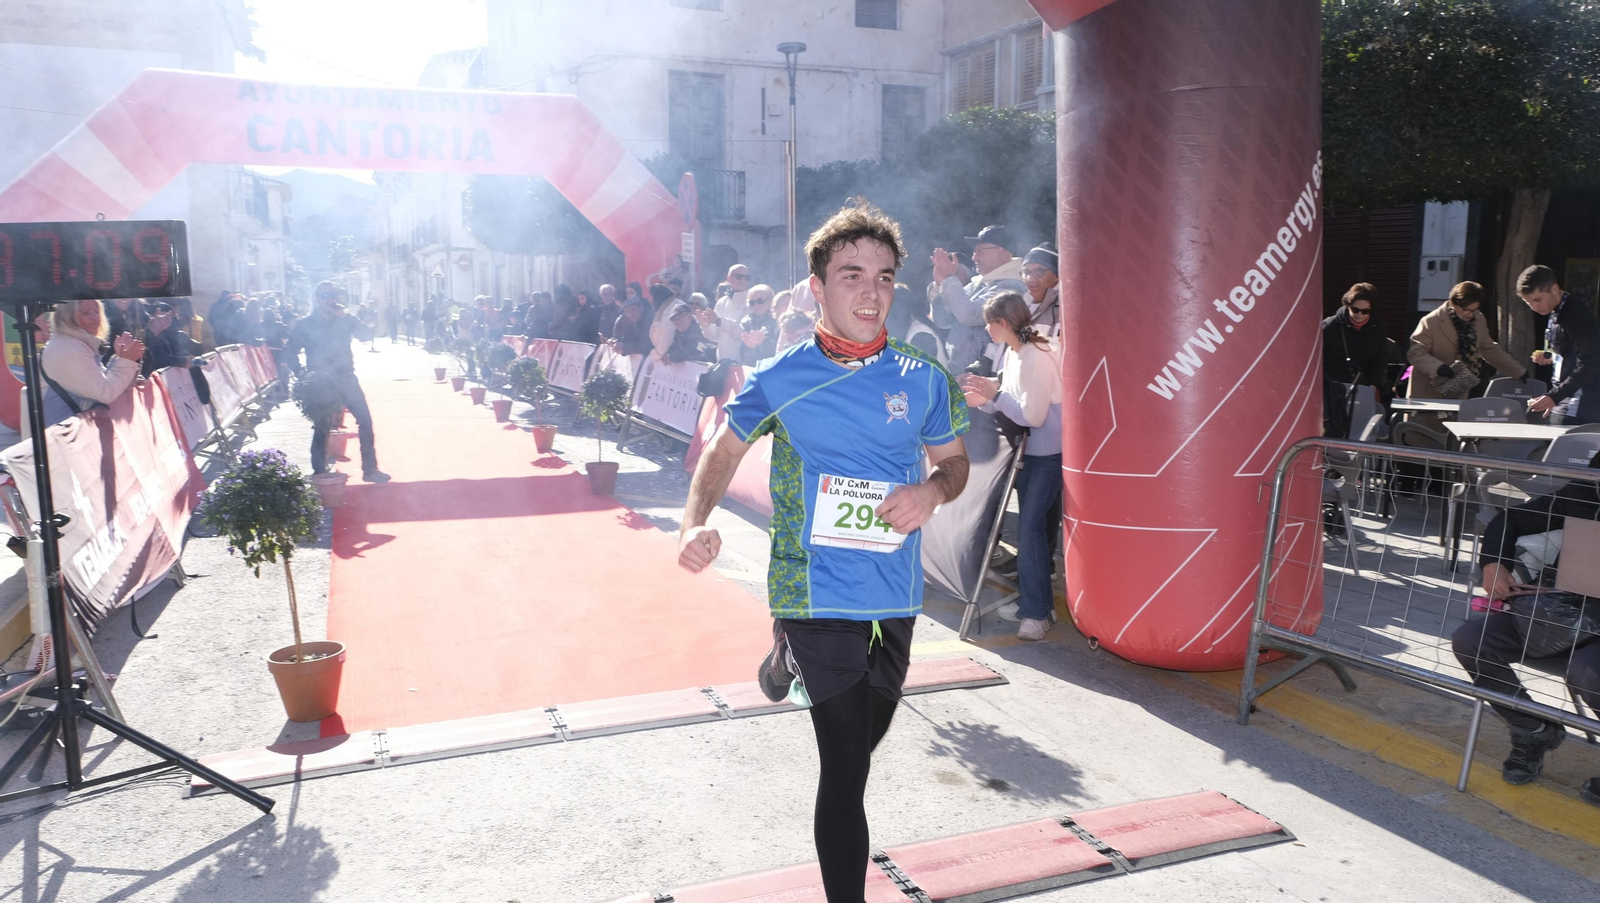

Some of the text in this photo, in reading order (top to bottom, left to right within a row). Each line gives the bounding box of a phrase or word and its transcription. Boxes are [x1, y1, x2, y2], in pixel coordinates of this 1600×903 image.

[236, 81, 502, 116] AYUNTAMIENTO
[246, 114, 495, 162] CANTORIA
[829, 487, 883, 501] LA PÓLVORA
[834, 477, 870, 490] IV CxM
